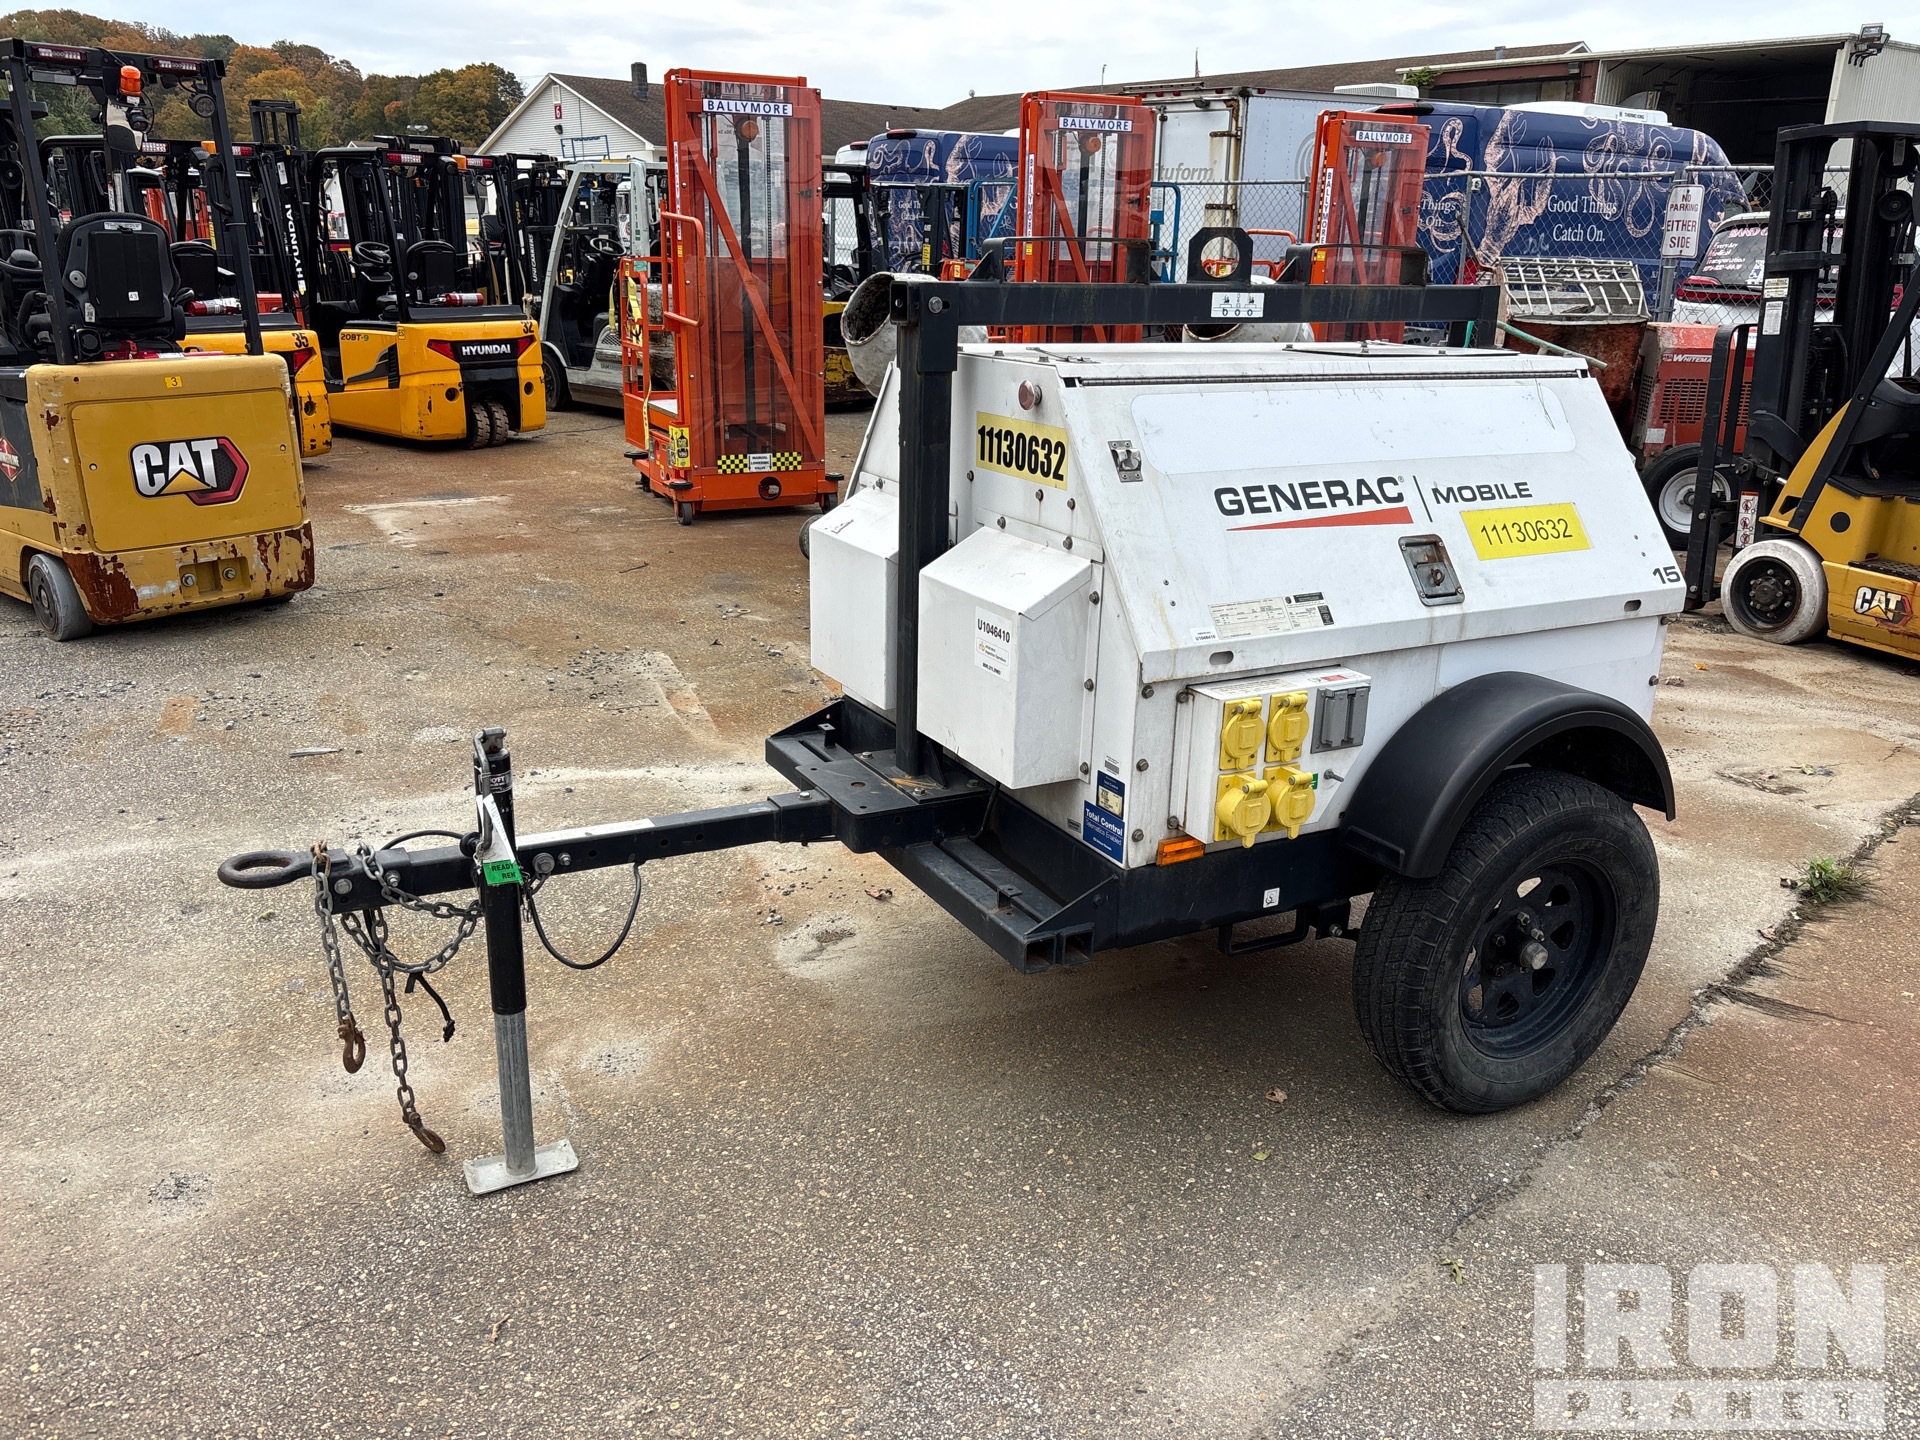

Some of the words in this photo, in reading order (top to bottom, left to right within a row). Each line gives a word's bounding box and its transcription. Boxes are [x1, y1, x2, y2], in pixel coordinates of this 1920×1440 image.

[556, 106, 561, 118] 6
[707, 100, 789, 115] BALLYMORE
[1062, 118, 1130, 131] BALLYMORE
[1358, 132, 1410, 143] BALLYMORE
[1548, 194, 1578, 213] Good
[1582, 196, 1618, 215] Things
[1682, 194, 1692, 203] NO
[1319, 171, 1333, 244] BALLYMORE
[1421, 199, 1457, 214] Things
[1669, 203, 1699, 213] PARKING
[1426, 215, 1445, 228] On.
[1666, 219, 1697, 233] EITHER
[1553, 223, 1584, 242] Catch
[1586, 225, 1606, 242] On.
[284, 204, 304, 279] HYUNDAI
[1669, 237, 1691, 249] SIDE
[129, 292, 138, 300] 43
[522, 321, 535, 335] 32
[291, 332, 310, 349] 35
[340, 333, 369, 342] 20BT-9
[462, 344, 511, 356] HYUNDAI
[1673, 354, 1712, 363] WHITEMA
[170, 376, 178, 387] 3
[977, 424, 1066, 482] 11130632
[130, 438, 219, 496] CAT
[1432, 481, 1533, 505] MOBILE
[1480, 518, 1574, 547] 11130632
[1652, 565, 1682, 585] 15
[1855, 586, 1902, 621] CAT
[977, 618, 1011, 643] U1046410
[1085, 808, 1100, 823] Total
[1100, 817, 1123, 837] Control
[491, 862, 515, 872] READY
[502, 872, 517, 880] REN
